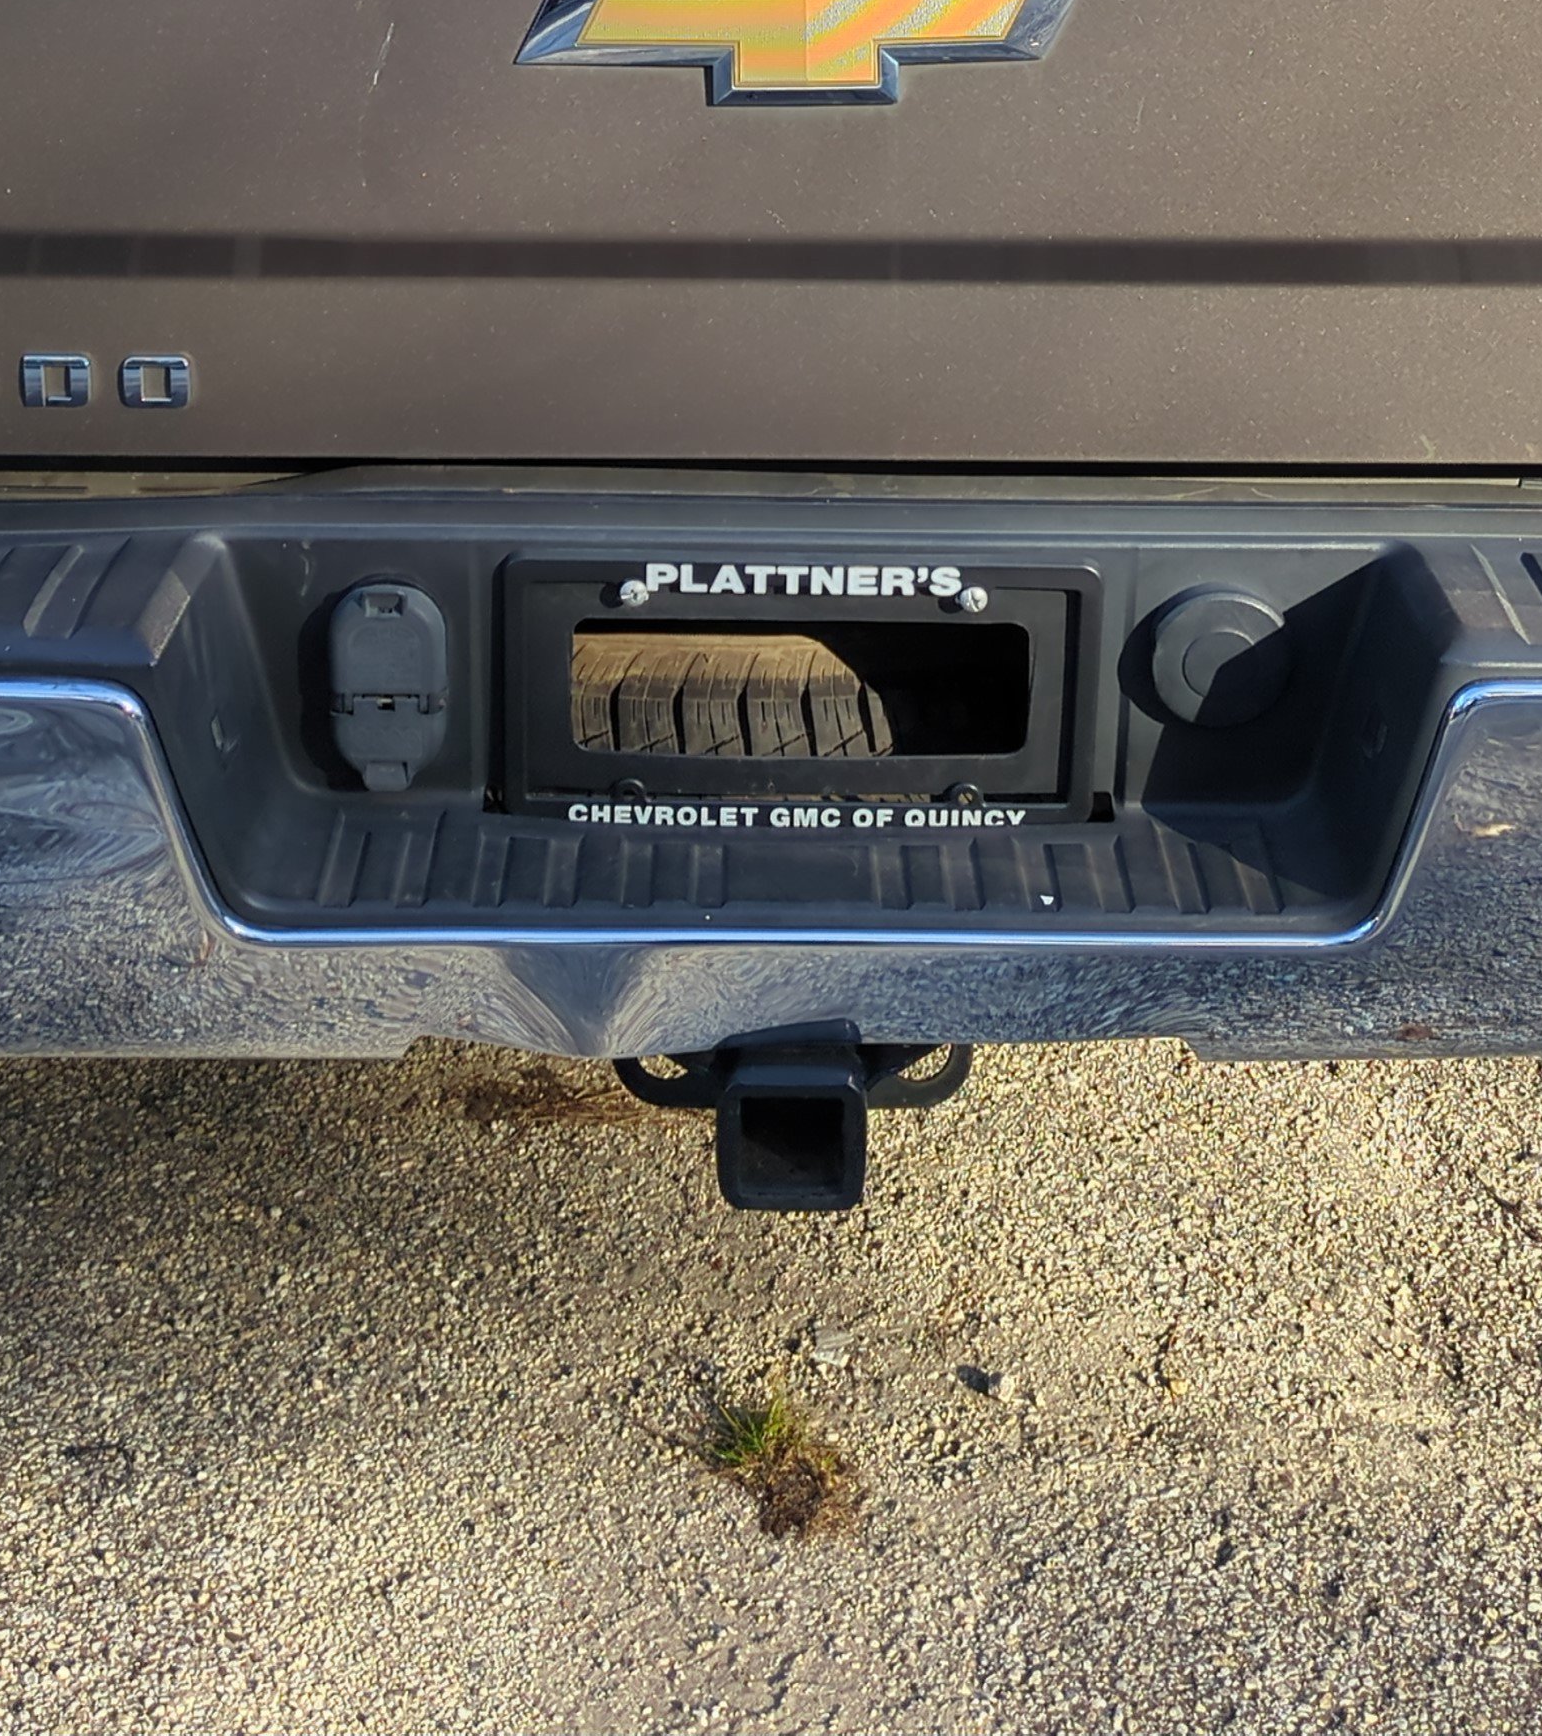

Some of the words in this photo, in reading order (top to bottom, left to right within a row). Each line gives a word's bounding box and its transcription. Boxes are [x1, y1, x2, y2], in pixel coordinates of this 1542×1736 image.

[645, 563, 963, 597] PLATTNER'S
[567, 804, 759, 826] CHEVROLET
[769, 807, 841, 829] GMC
[852, 808, 893, 828] OF
[904, 809, 1026, 828] QUINCY
